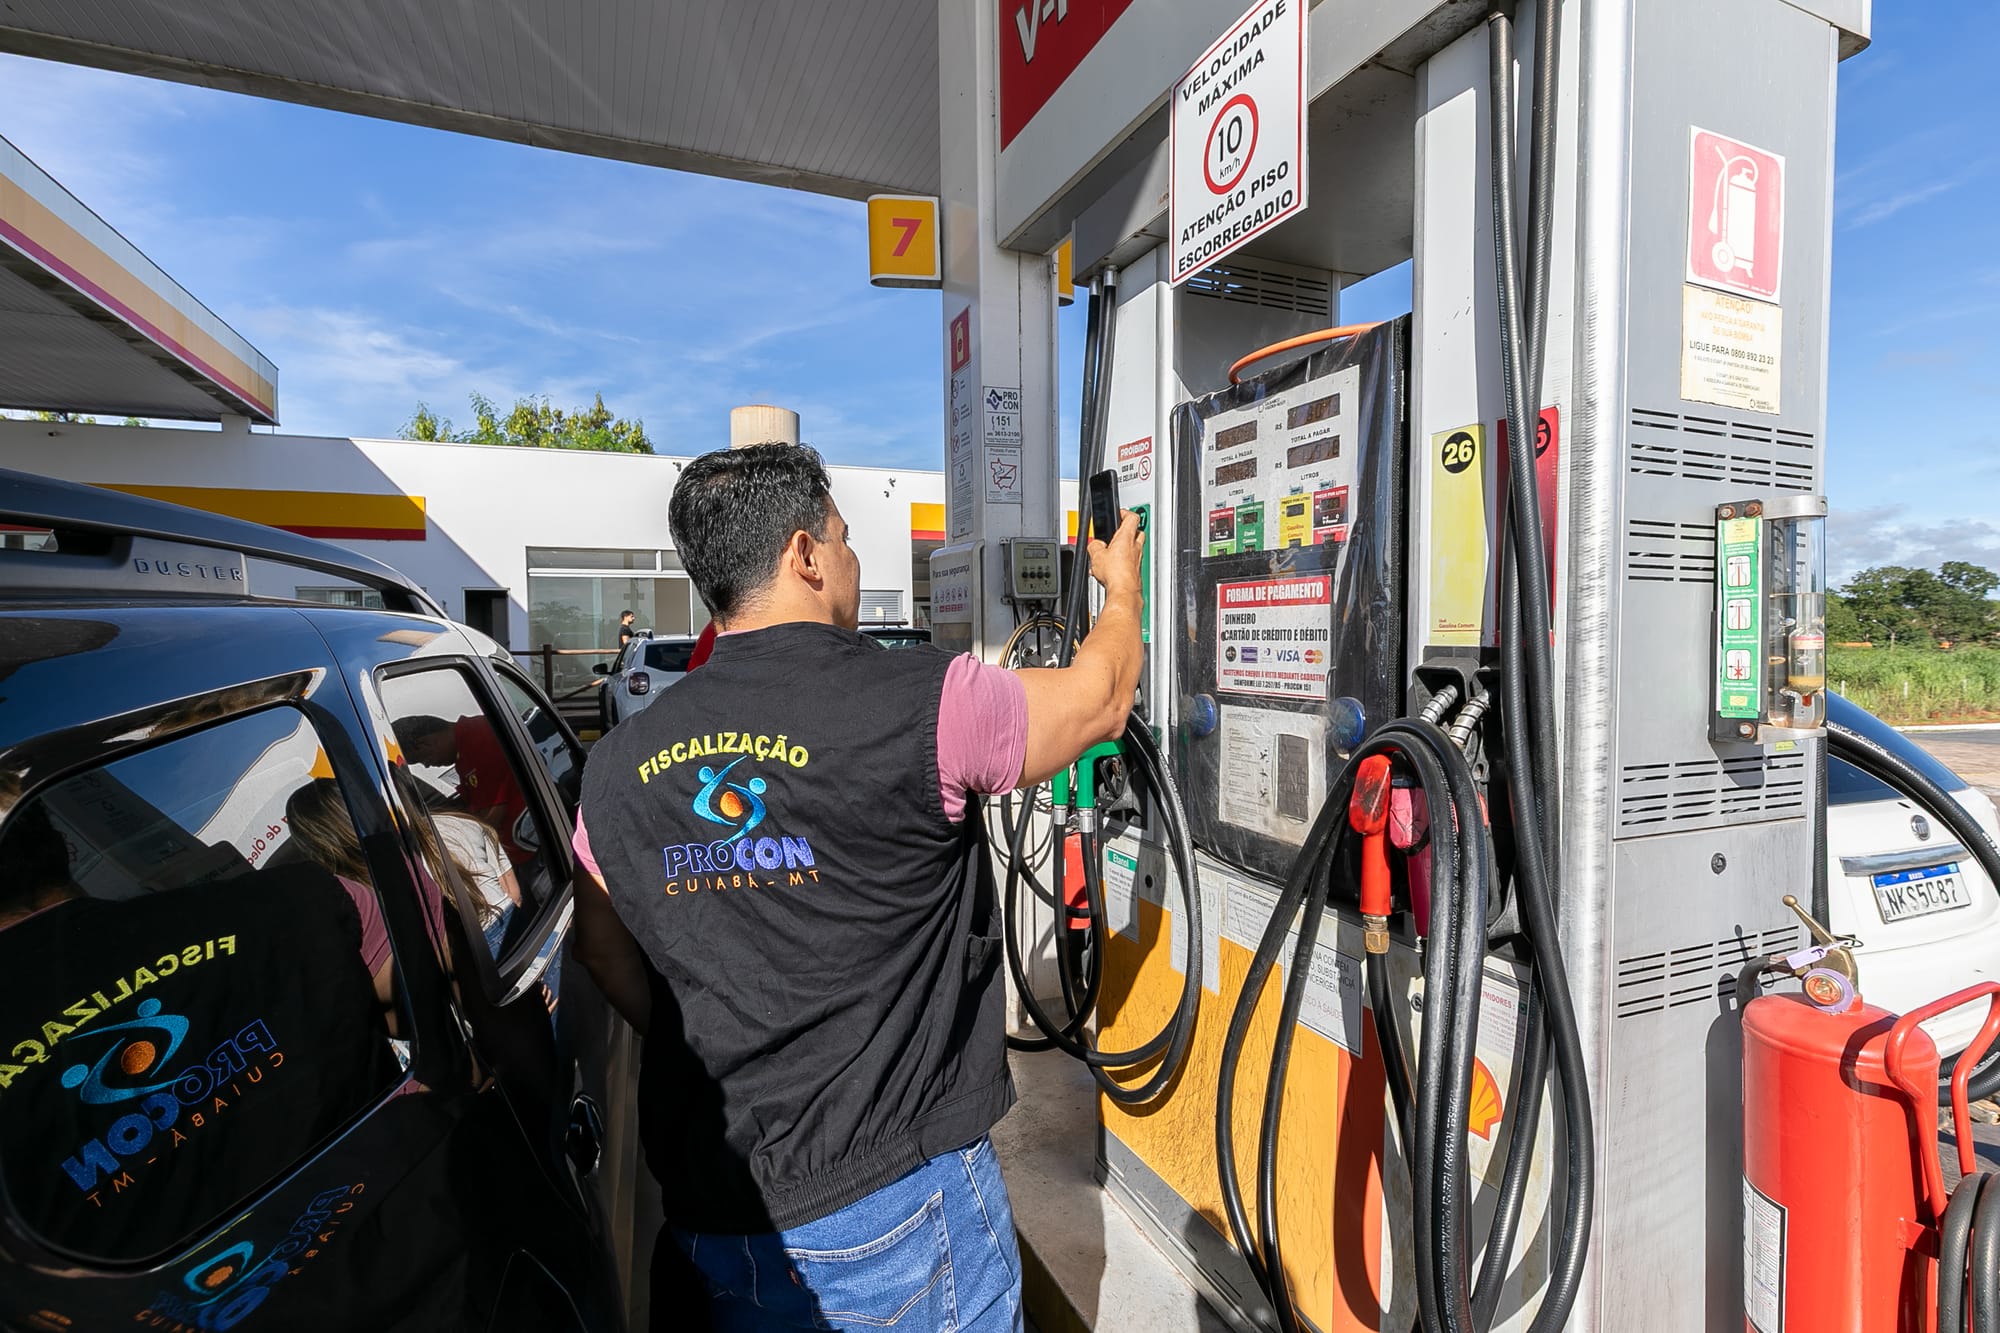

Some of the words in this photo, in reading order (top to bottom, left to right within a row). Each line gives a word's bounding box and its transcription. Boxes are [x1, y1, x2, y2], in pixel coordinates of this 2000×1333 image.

[1182, 0, 1286, 101] VELOCIDADE
[1198, 48, 1265, 116] MÁXIMA
[1218, 115, 1243, 163] 10
[1219, 157, 1241, 179] km/h
[1181, 190, 1246, 246] ATENÇÃO
[1251, 160, 1289, 199] PISO
[892, 218, 923, 257] 7
[1178, 189, 1293, 273] ESCORREGADIO
[1690, 340, 1710, 353] LIGUE
[1712, 344, 1729, 356] PARA
[1003, 391, 1018, 401] PRO
[1003, 401, 1019, 410] CON
[996, 416, 1011, 426] 151
[1291, 434, 1307, 444] TOTAL
[1313, 427, 1331, 437] PAGAR
[1444, 439, 1473, 466] 26
[1300, 471, 1320, 480] LITROS
[133, 558, 243, 581] DUSTER
[1226, 587, 1254, 603] FORMA
[1255, 585, 1267, 601] DE
[1267, 581, 1323, 601] PAGAMENTO
[1225, 613, 1256, 625] DINHEIRO
[1224, 627, 1250, 641] CARTÃO
[1252, 629, 1260, 641] DE
[1261, 627, 1292, 642] CRÉDITO
[1294, 629, 1298, 641] E
[1300, 626, 1328, 642] DÉBITO
[1275, 649, 1300, 662] VISA
[637, 732, 809, 784] FISCALIZAÇÃO
[663, 836, 815, 879] PROCON
[665, 873, 759, 896] CUIABÁ
[1884, 877, 1958, 916] NKS5C87
